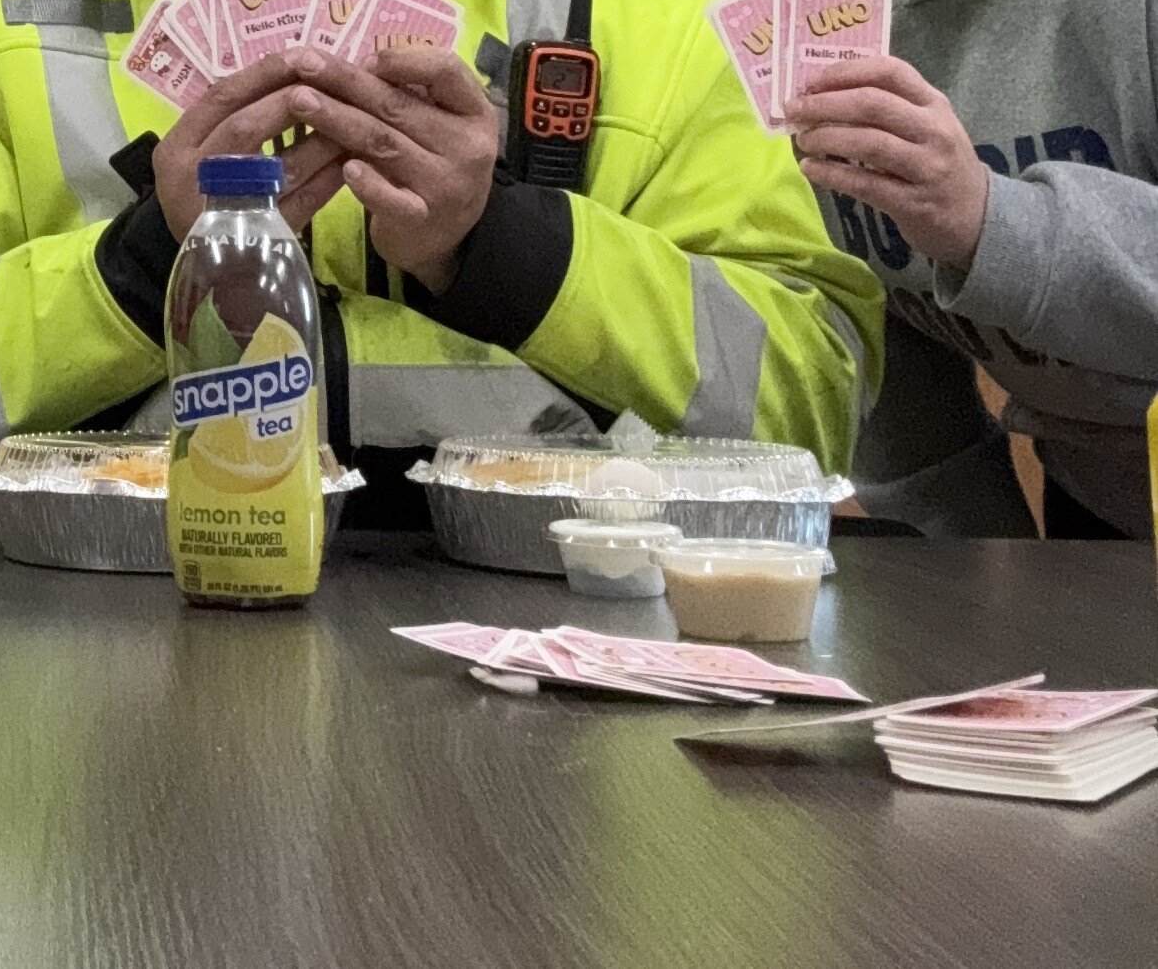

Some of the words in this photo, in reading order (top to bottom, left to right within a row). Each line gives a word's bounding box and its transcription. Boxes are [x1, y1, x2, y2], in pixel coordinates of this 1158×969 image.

[244, 19, 275, 34] Hello
[805, 47, 836, 59] Hello
[174, 354, 307, 417] snapple
[257, 415, 292, 437] tea
[179, 501, 241, 524] lemon
[249, 505, 286, 525] tea
[181, 529, 229, 544] NATURALLY
[231, 532, 282, 545] FLAVORED
[218, 546, 253, 557] NATURAL
[255, 547, 287, 558] FLAVORS
